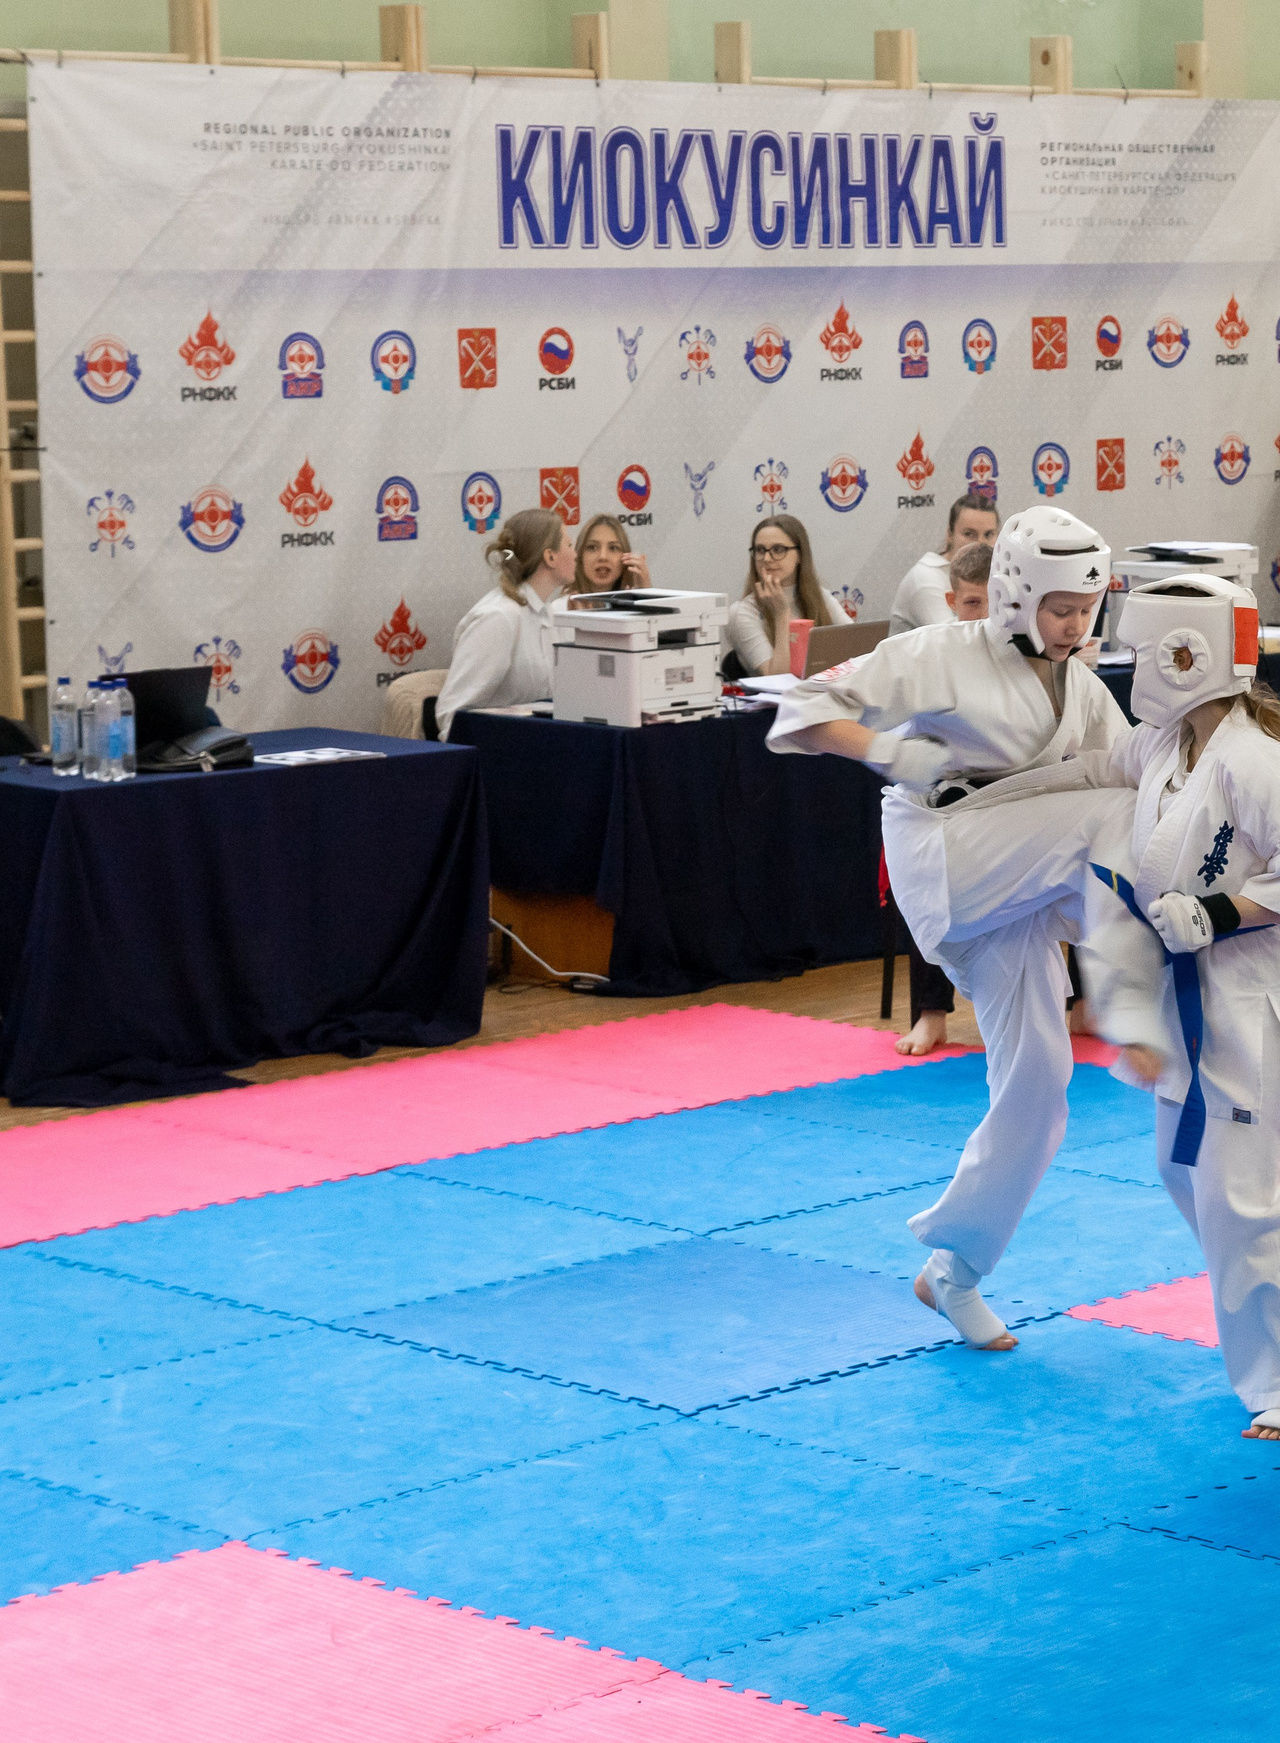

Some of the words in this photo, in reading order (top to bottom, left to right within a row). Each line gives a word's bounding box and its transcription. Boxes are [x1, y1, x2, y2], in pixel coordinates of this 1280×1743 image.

[203, 122, 277, 135] REGIONAL
[283, 124, 334, 137] PUBLIC
[341, 126, 451, 139] ORGANIZATION
[1040, 141, 1124, 153] РЕГИОНАЛЬНАЯ
[1128, 143, 1216, 154] ОБЩЕСТВЕННАЯ
[1040, 156, 1117, 167] ОРГАНИЗАЦИЯ
[495, 112, 1006, 250] КИОКУСИНКАЙ
[1095, 360, 1123, 372] РСБИ
[1215, 353, 1249, 366] РНФКК
[821, 367, 862, 382] РНФКК
[539, 377, 576, 391] РСБИ
[181, 386, 237, 402] РНФКК
[897, 494, 935, 509] РНФКК
[281, 531, 334, 548] РНФКК
